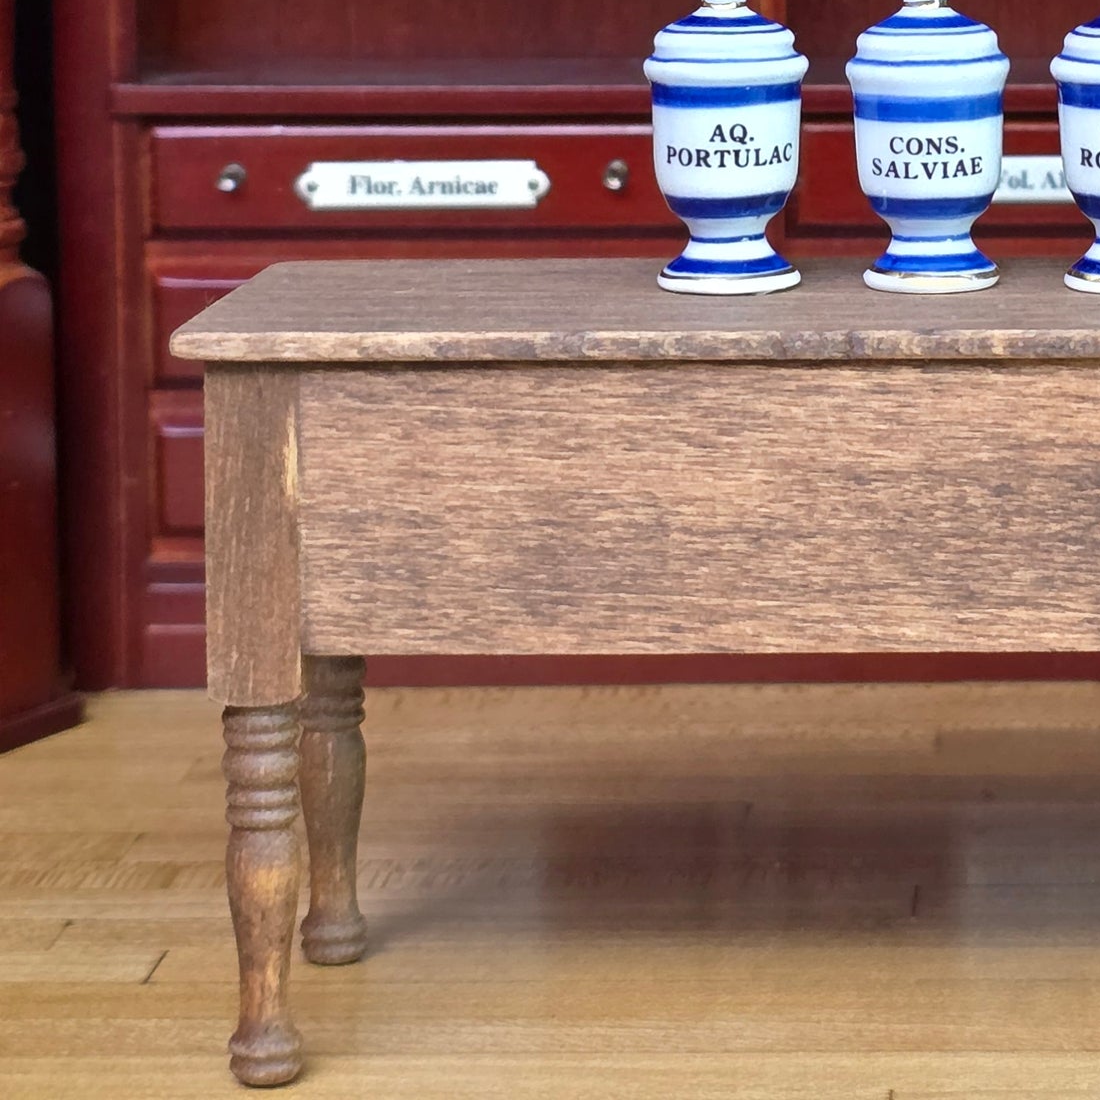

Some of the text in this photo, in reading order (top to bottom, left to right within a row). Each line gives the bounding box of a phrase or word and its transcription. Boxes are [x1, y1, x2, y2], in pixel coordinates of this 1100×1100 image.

[709, 124, 755, 144] AQ.
[666, 143, 793, 168] PORTULAC
[889, 136, 966, 155] CONS.
[871, 156, 983, 180] SALVIAE
[347, 174, 499, 196] Flor. Arnicae
[1000, 169, 1035, 190] ol.
